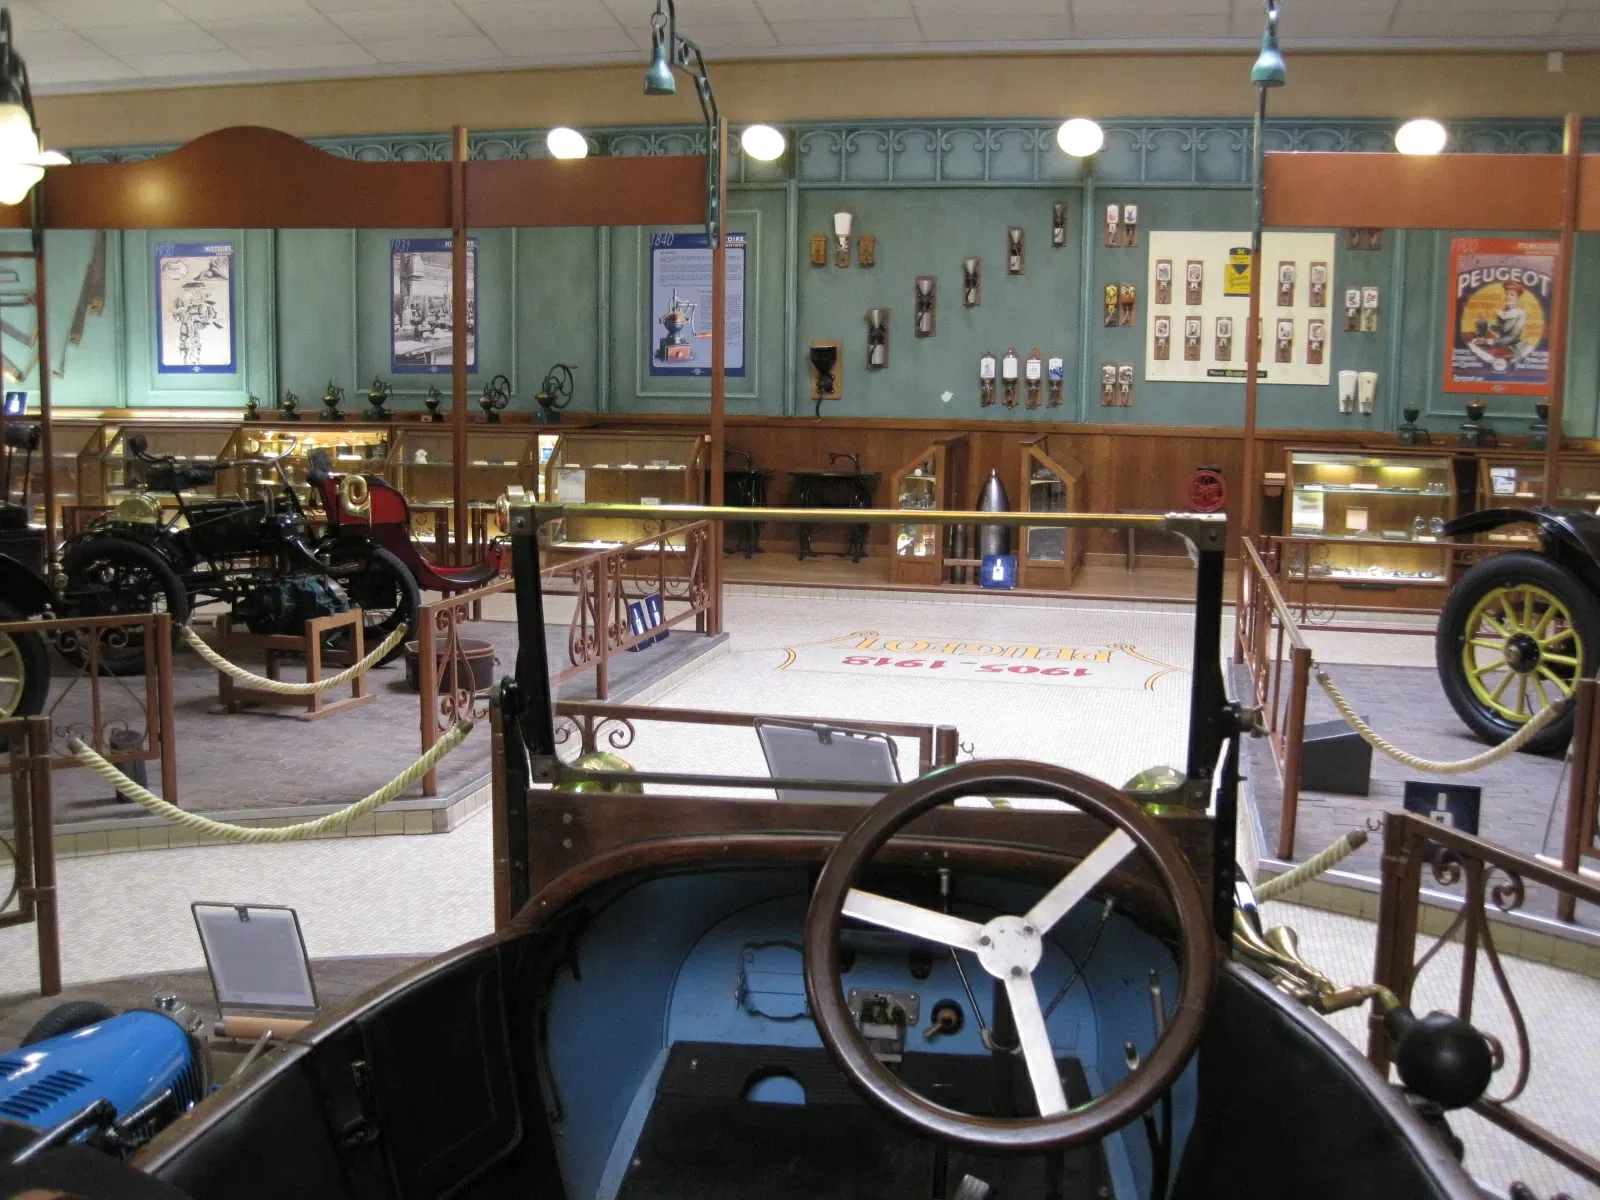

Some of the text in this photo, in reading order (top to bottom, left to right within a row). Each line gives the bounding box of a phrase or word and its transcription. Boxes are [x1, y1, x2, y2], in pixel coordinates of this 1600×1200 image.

[651, 232, 674, 247] 1840
[1457, 267, 1552, 298] PEUGEOT
[832, 635, 1114, 663] PEUGEOT
